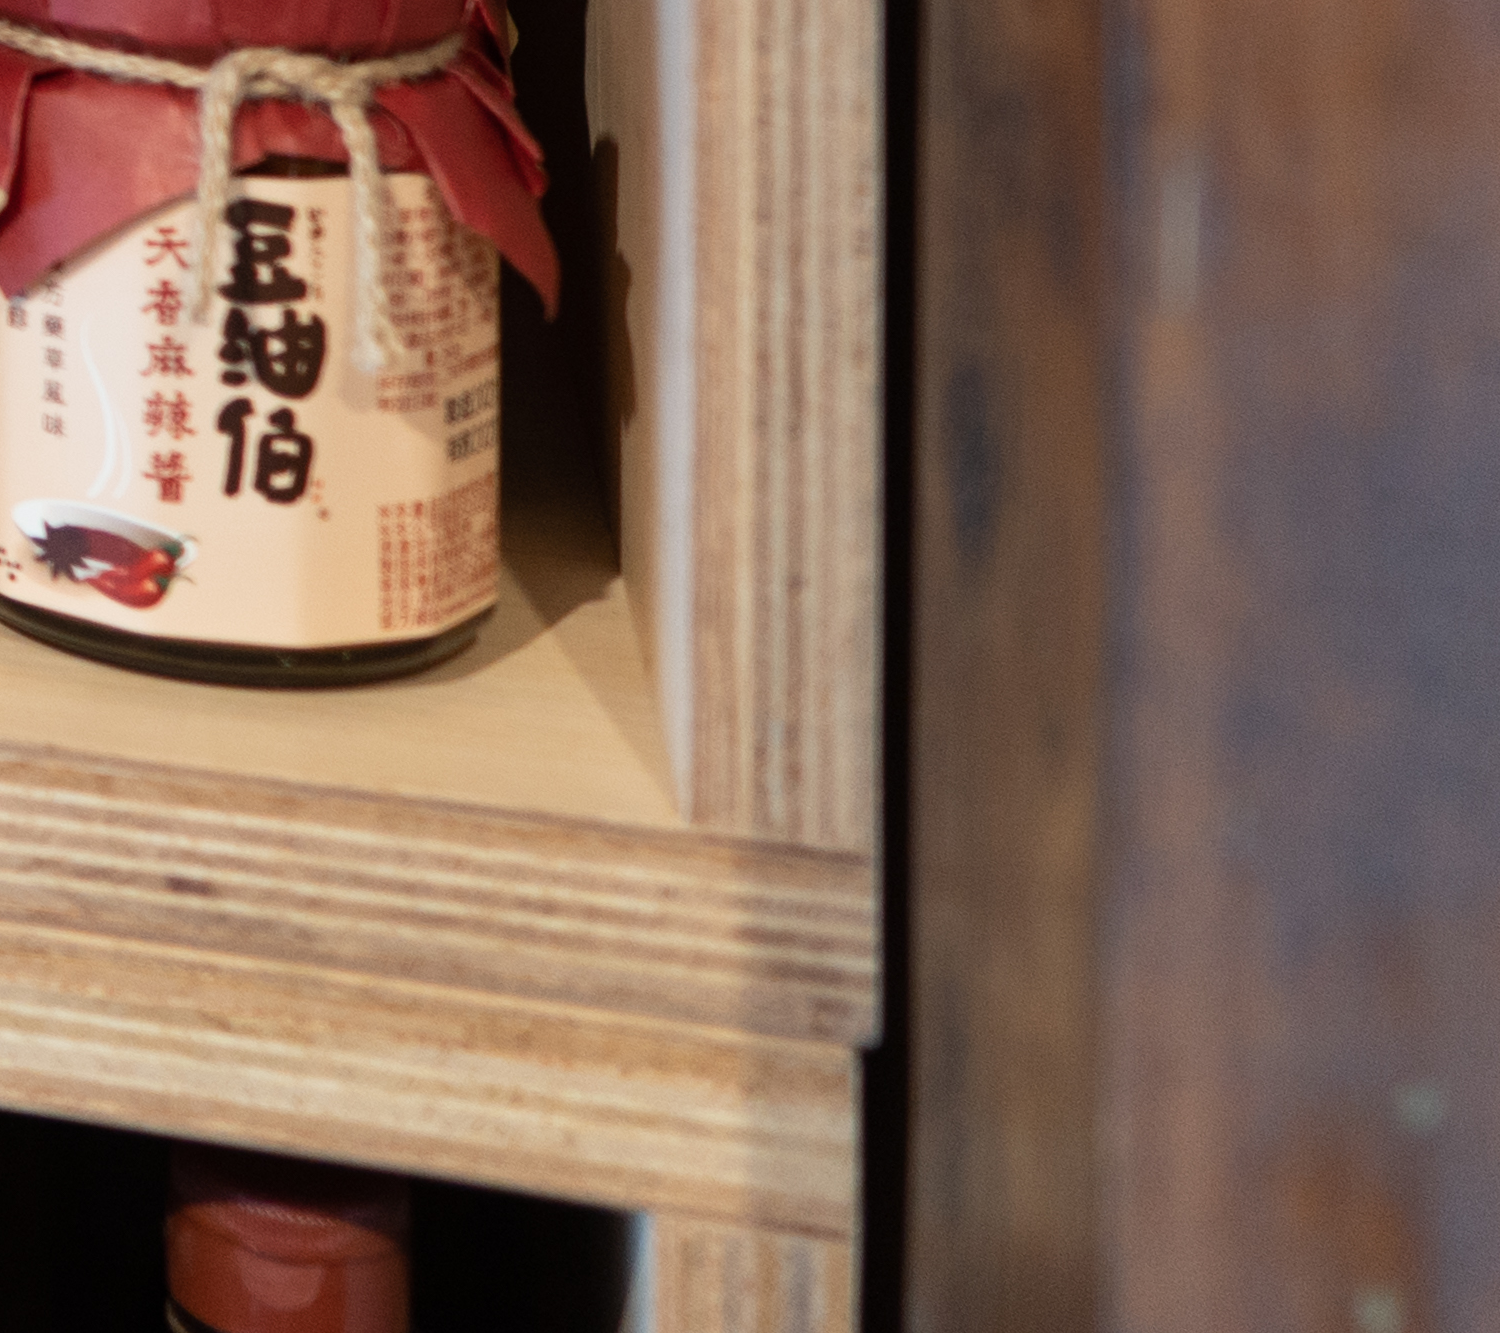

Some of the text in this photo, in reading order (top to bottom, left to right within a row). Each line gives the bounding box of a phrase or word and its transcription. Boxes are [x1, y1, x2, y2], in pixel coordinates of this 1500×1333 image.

[139, 225, 195, 504] 天香麻辣醬
[217, 197, 327, 505] 豆油伯
